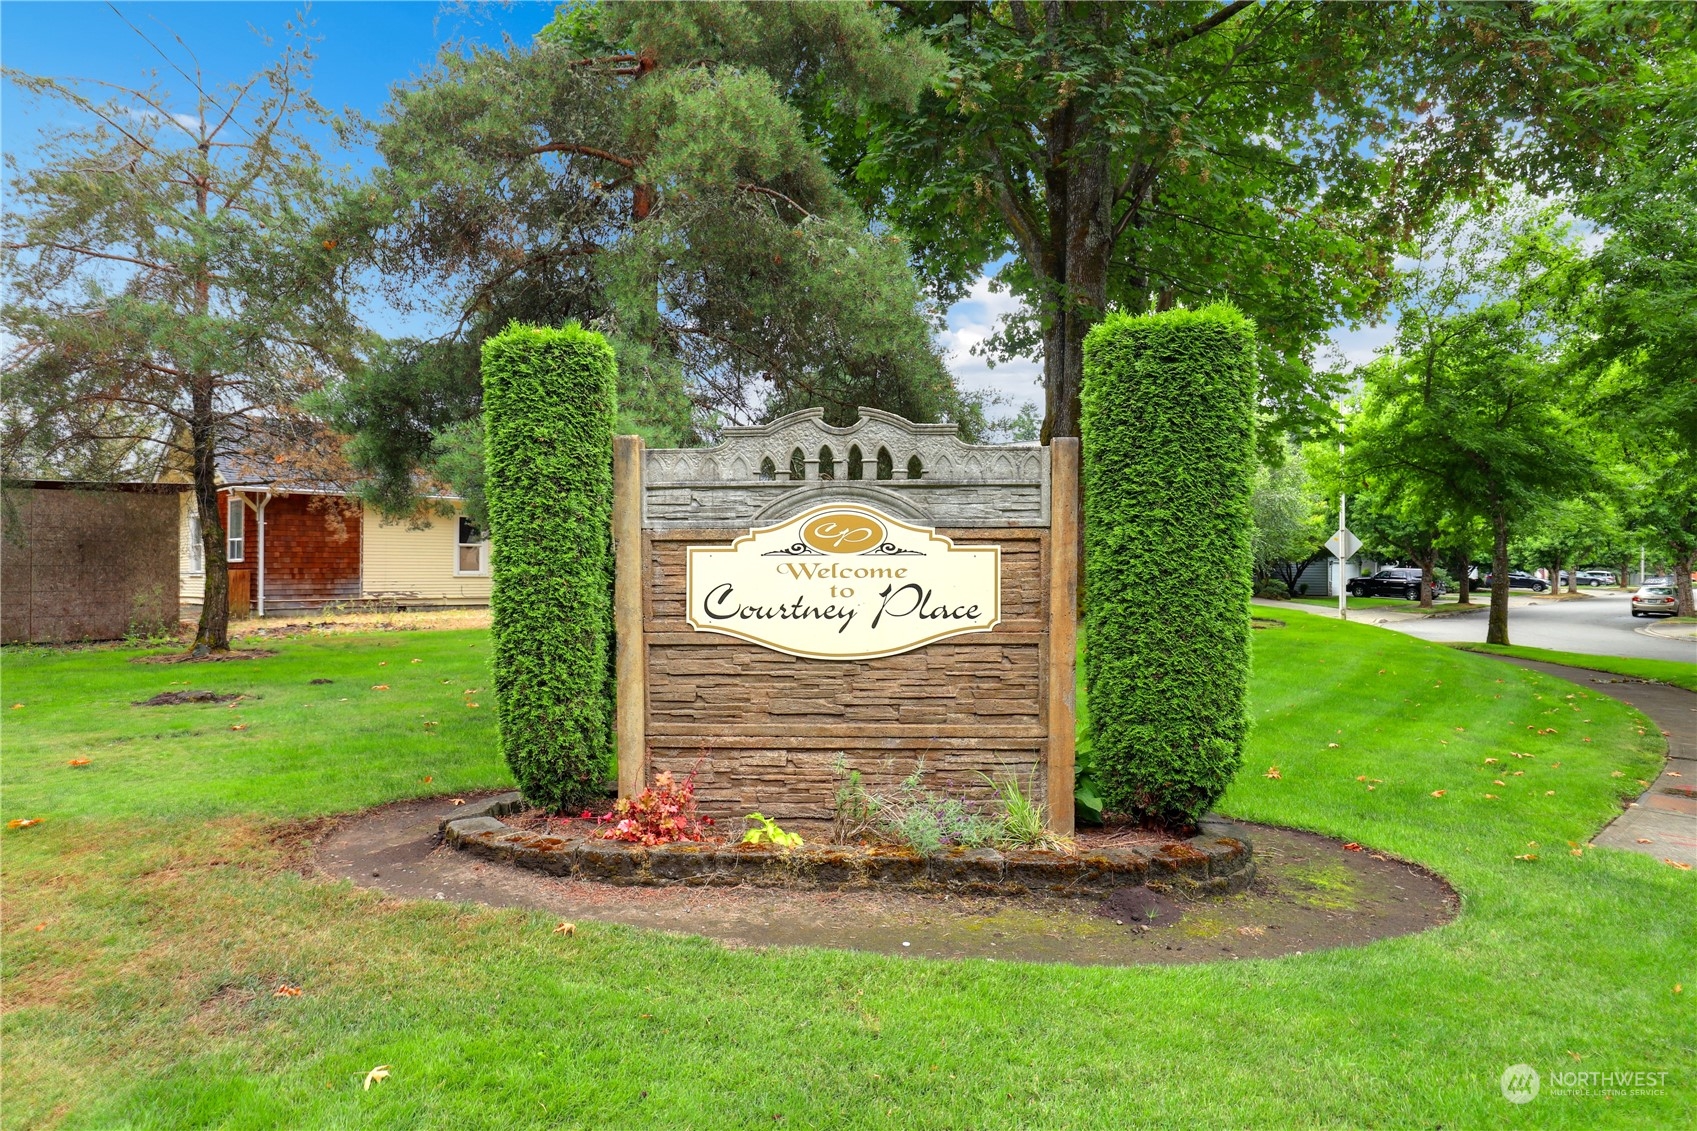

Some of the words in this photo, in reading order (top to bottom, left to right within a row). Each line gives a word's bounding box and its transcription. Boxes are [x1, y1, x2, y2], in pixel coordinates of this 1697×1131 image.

[776, 562, 908, 580] Welcome
[829, 584, 855, 598] to
[703, 583, 857, 633] Courtney
[871, 583, 982, 629] Place
